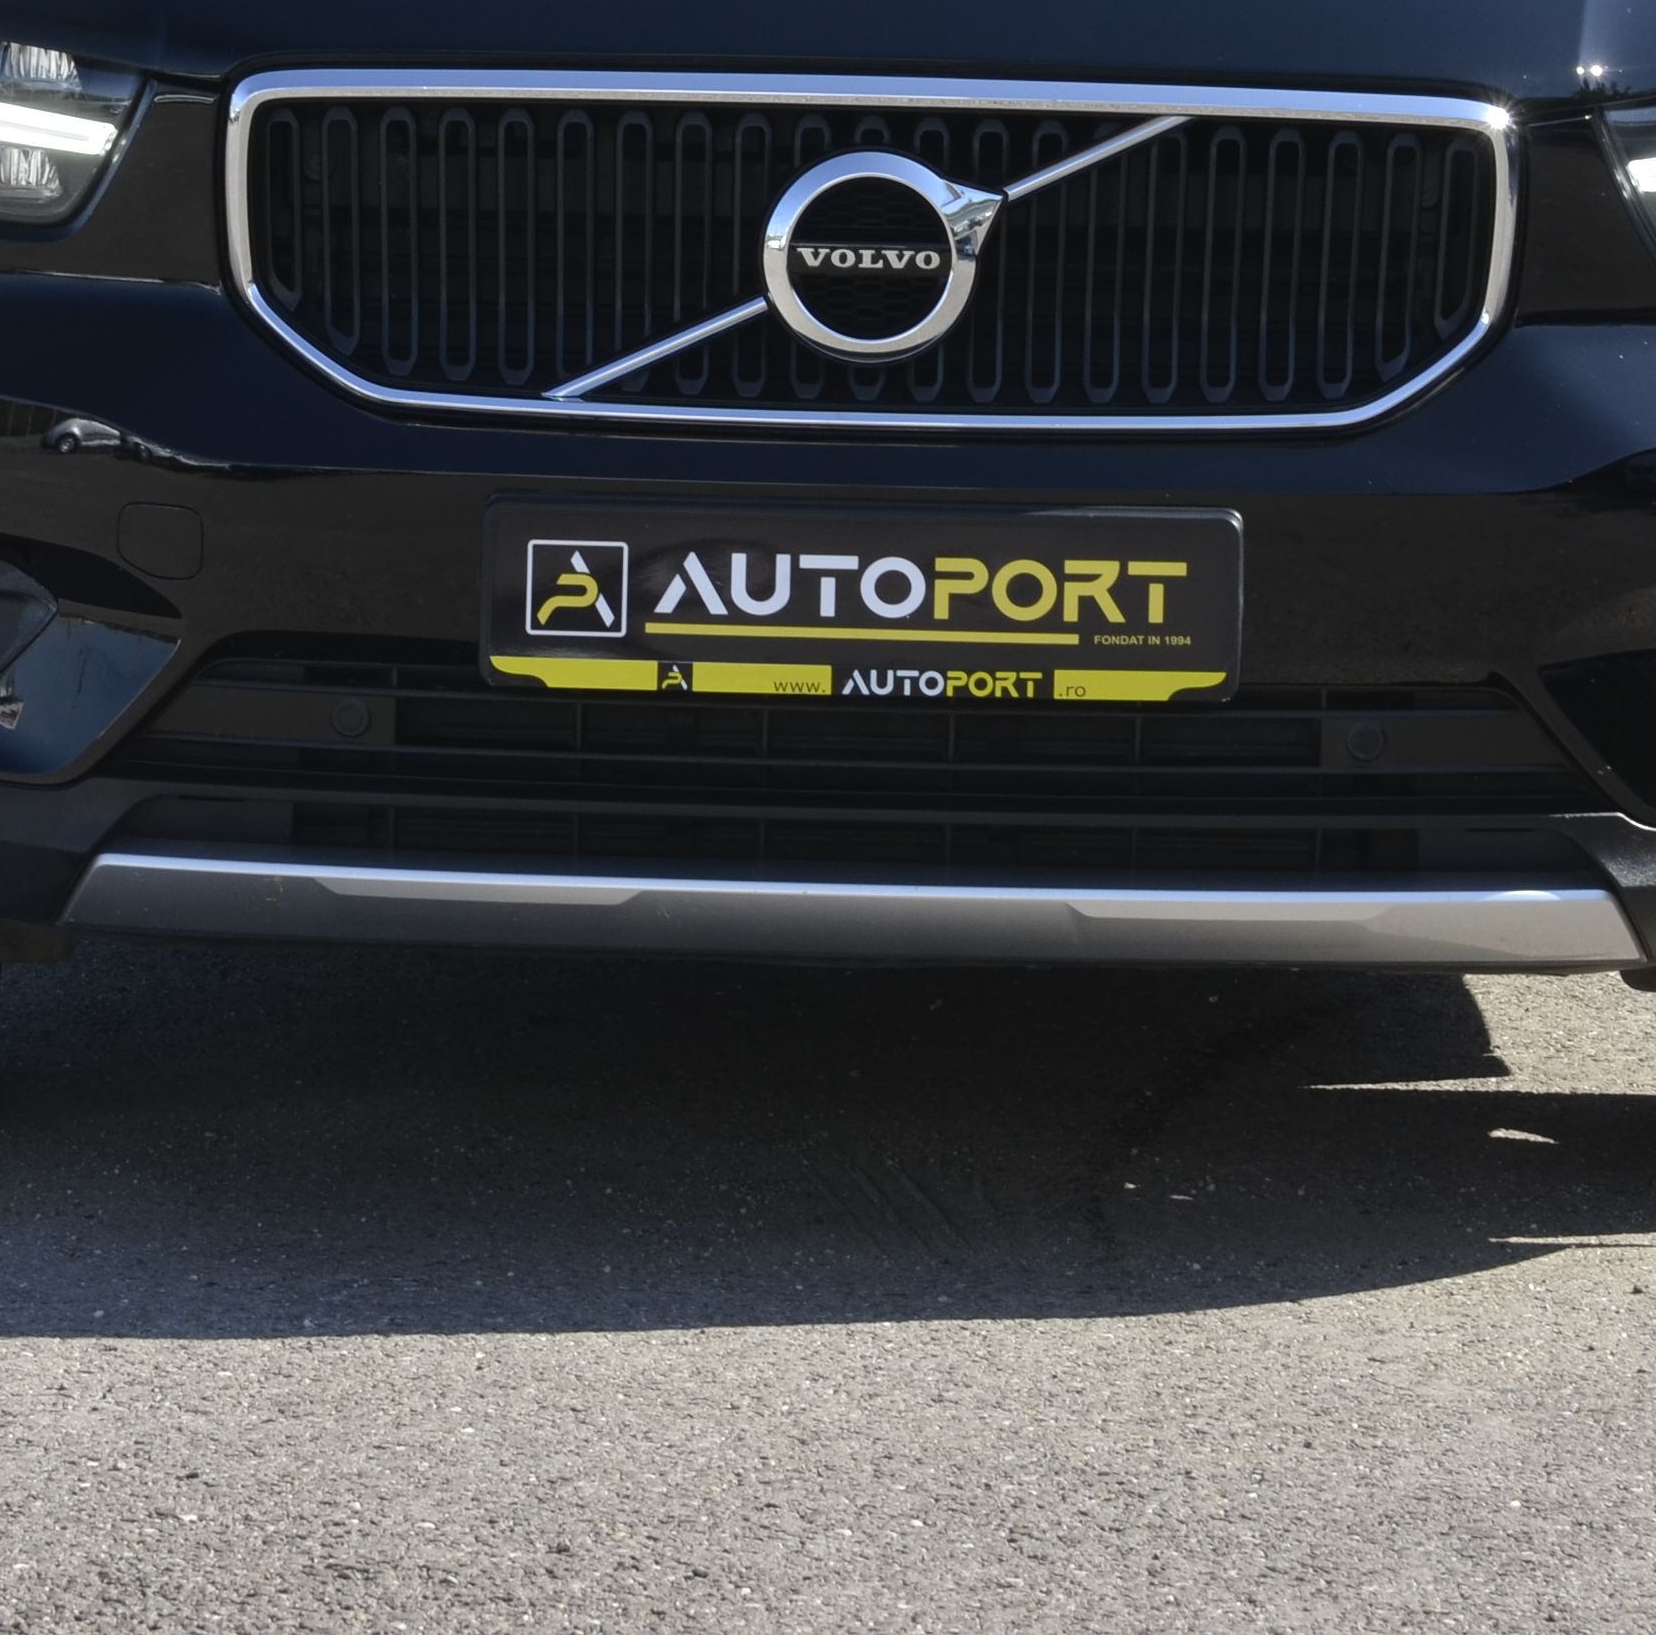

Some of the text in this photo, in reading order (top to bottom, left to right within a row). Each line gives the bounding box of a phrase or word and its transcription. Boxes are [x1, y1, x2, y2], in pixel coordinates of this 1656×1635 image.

[796, 247, 941, 270] VOLVO
[654, 551, 1189, 625] AUTOPORT
[1093, 634, 1192, 647] FONDAT IN 1994
[841, 668, 1043, 699] AUTOPORT
